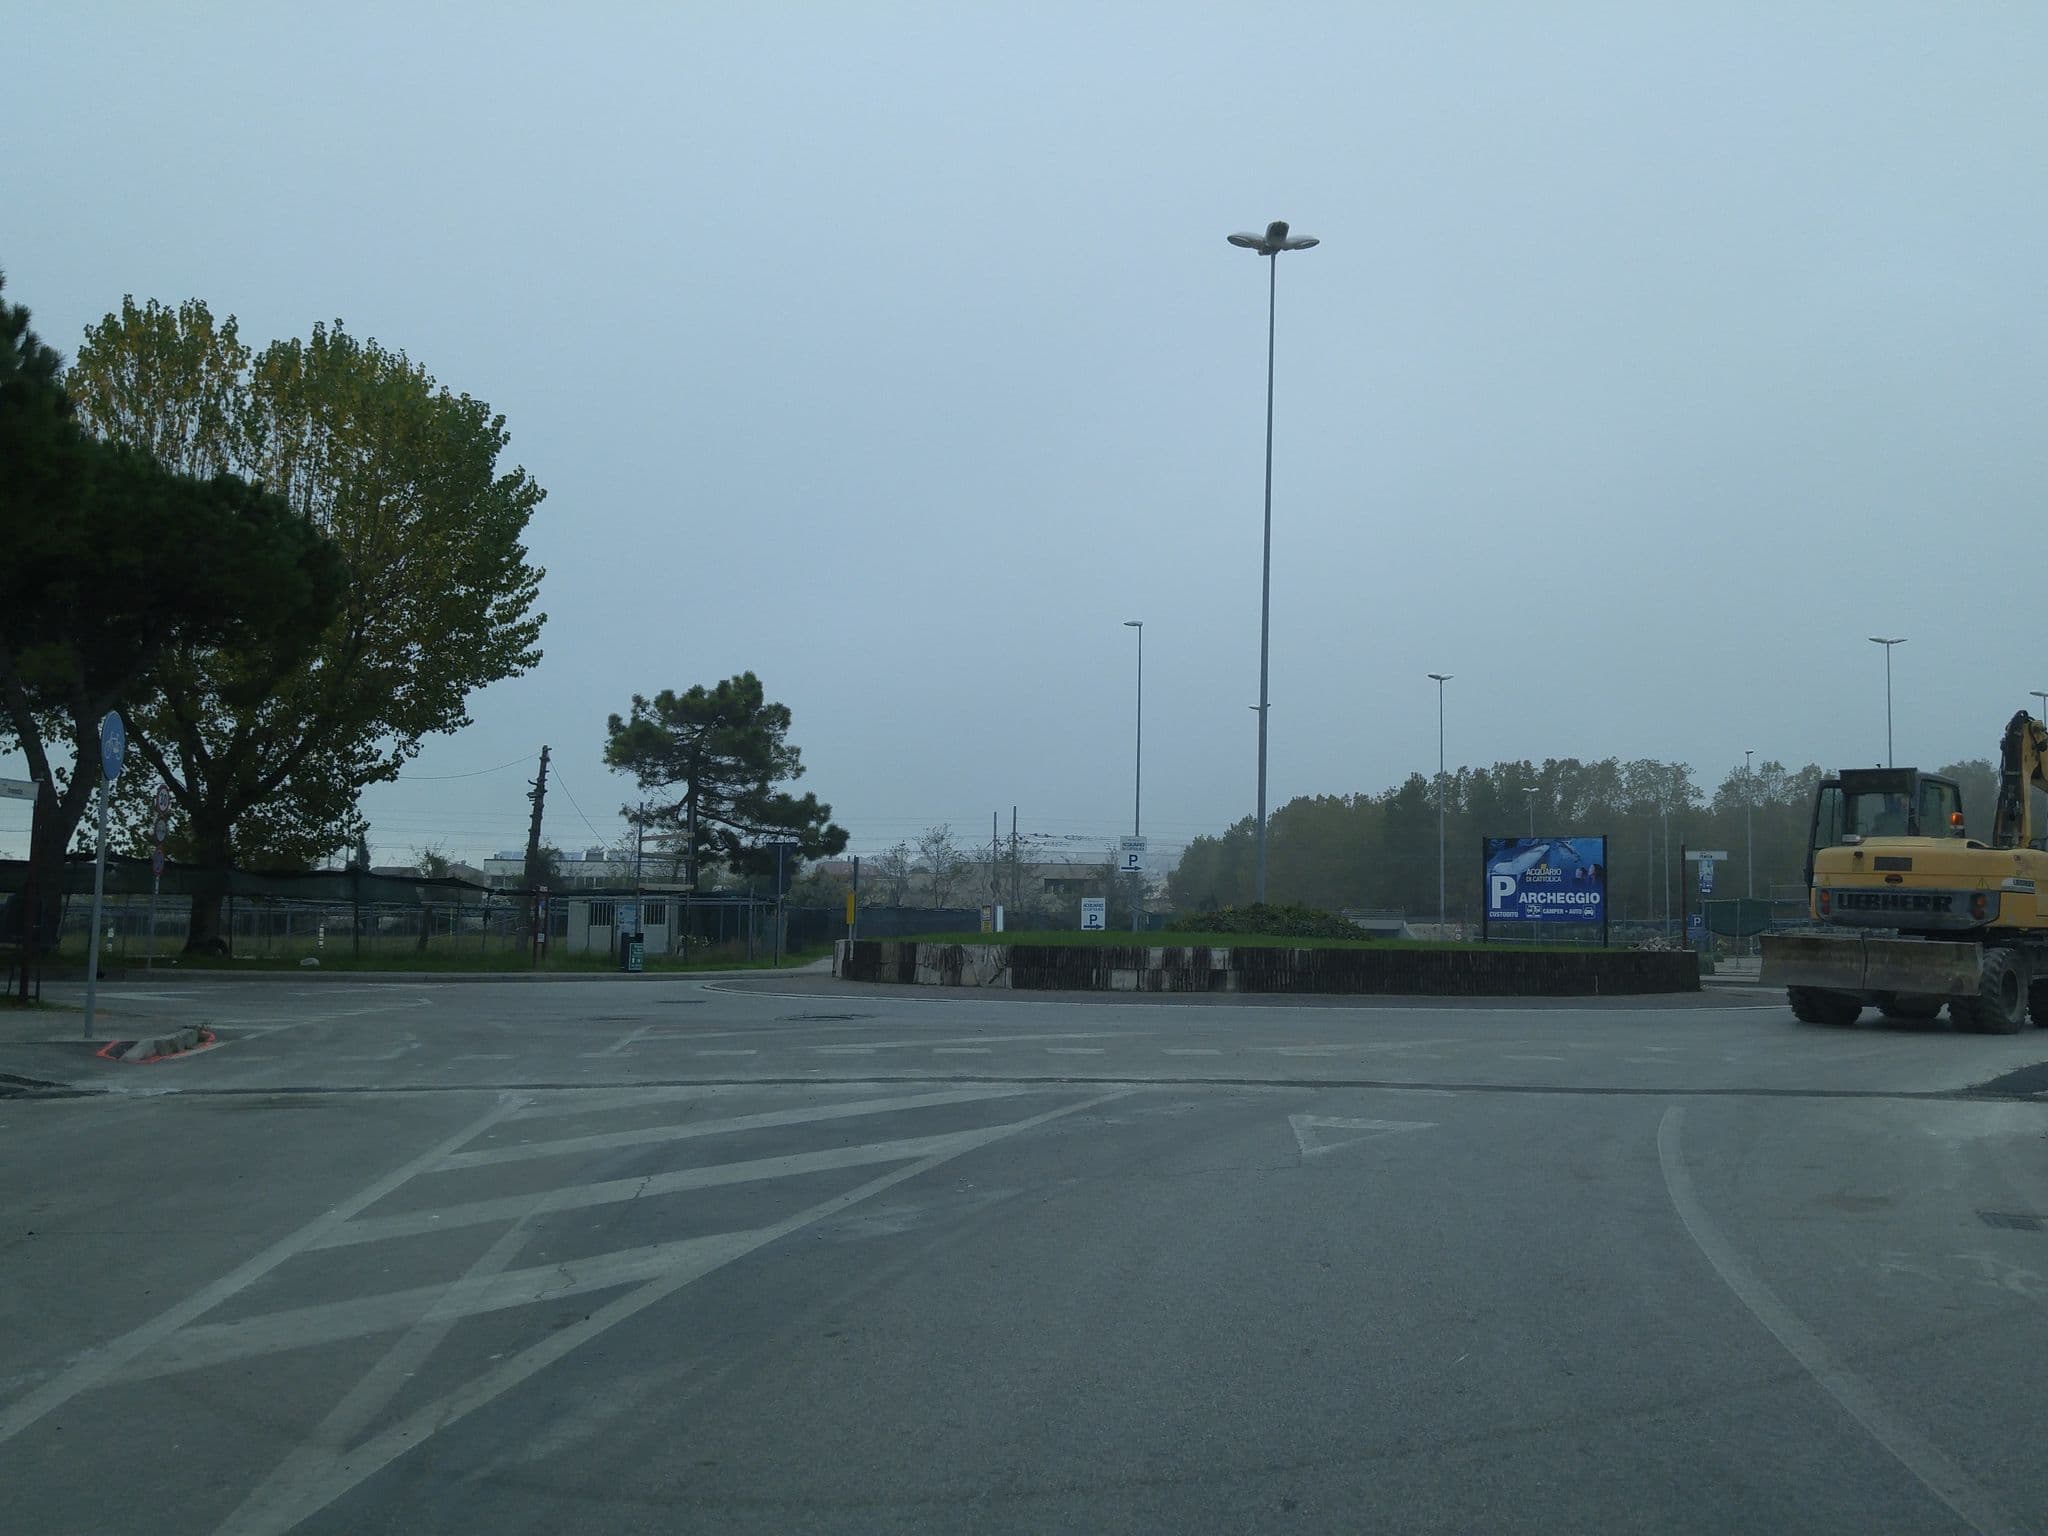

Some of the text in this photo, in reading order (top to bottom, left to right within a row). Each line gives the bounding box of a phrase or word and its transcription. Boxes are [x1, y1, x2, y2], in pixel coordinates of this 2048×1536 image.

[1129, 855, 1138, 866] P
[1526, 868, 1562, 876] ACQUARIO
[1837, 892, 1953, 912] LIEBHERR
[1089, 914, 1098, 925] P
[1694, 917, 1702, 926] P
